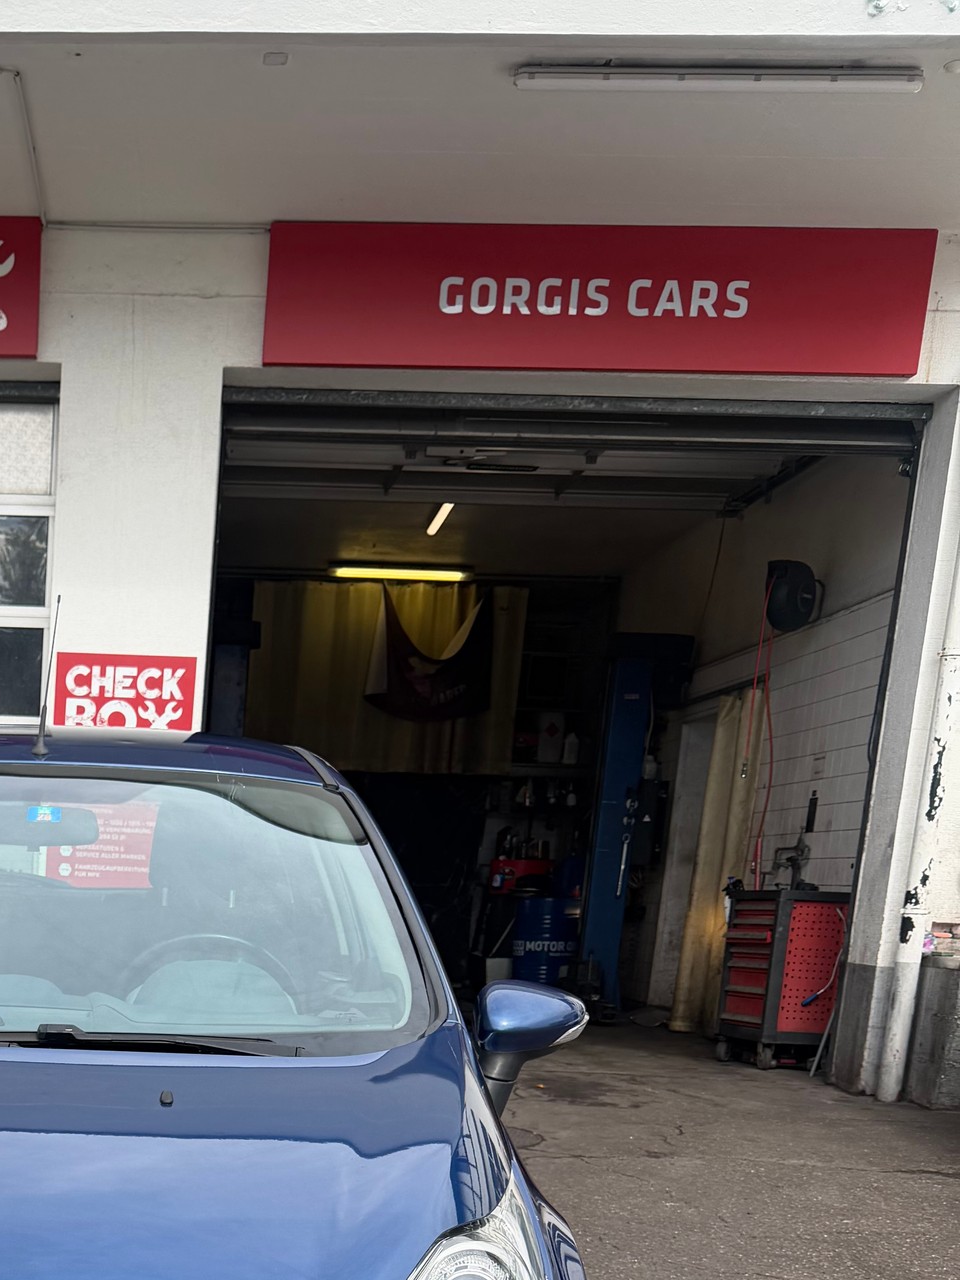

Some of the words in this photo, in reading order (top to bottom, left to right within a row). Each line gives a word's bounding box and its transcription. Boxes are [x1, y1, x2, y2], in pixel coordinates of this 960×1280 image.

[439, 276, 610, 316] GORGIS
[627, 279, 750, 318] CARS
[65, 664, 186, 700] CHECK
[526, 941, 565, 952] MOTOR
